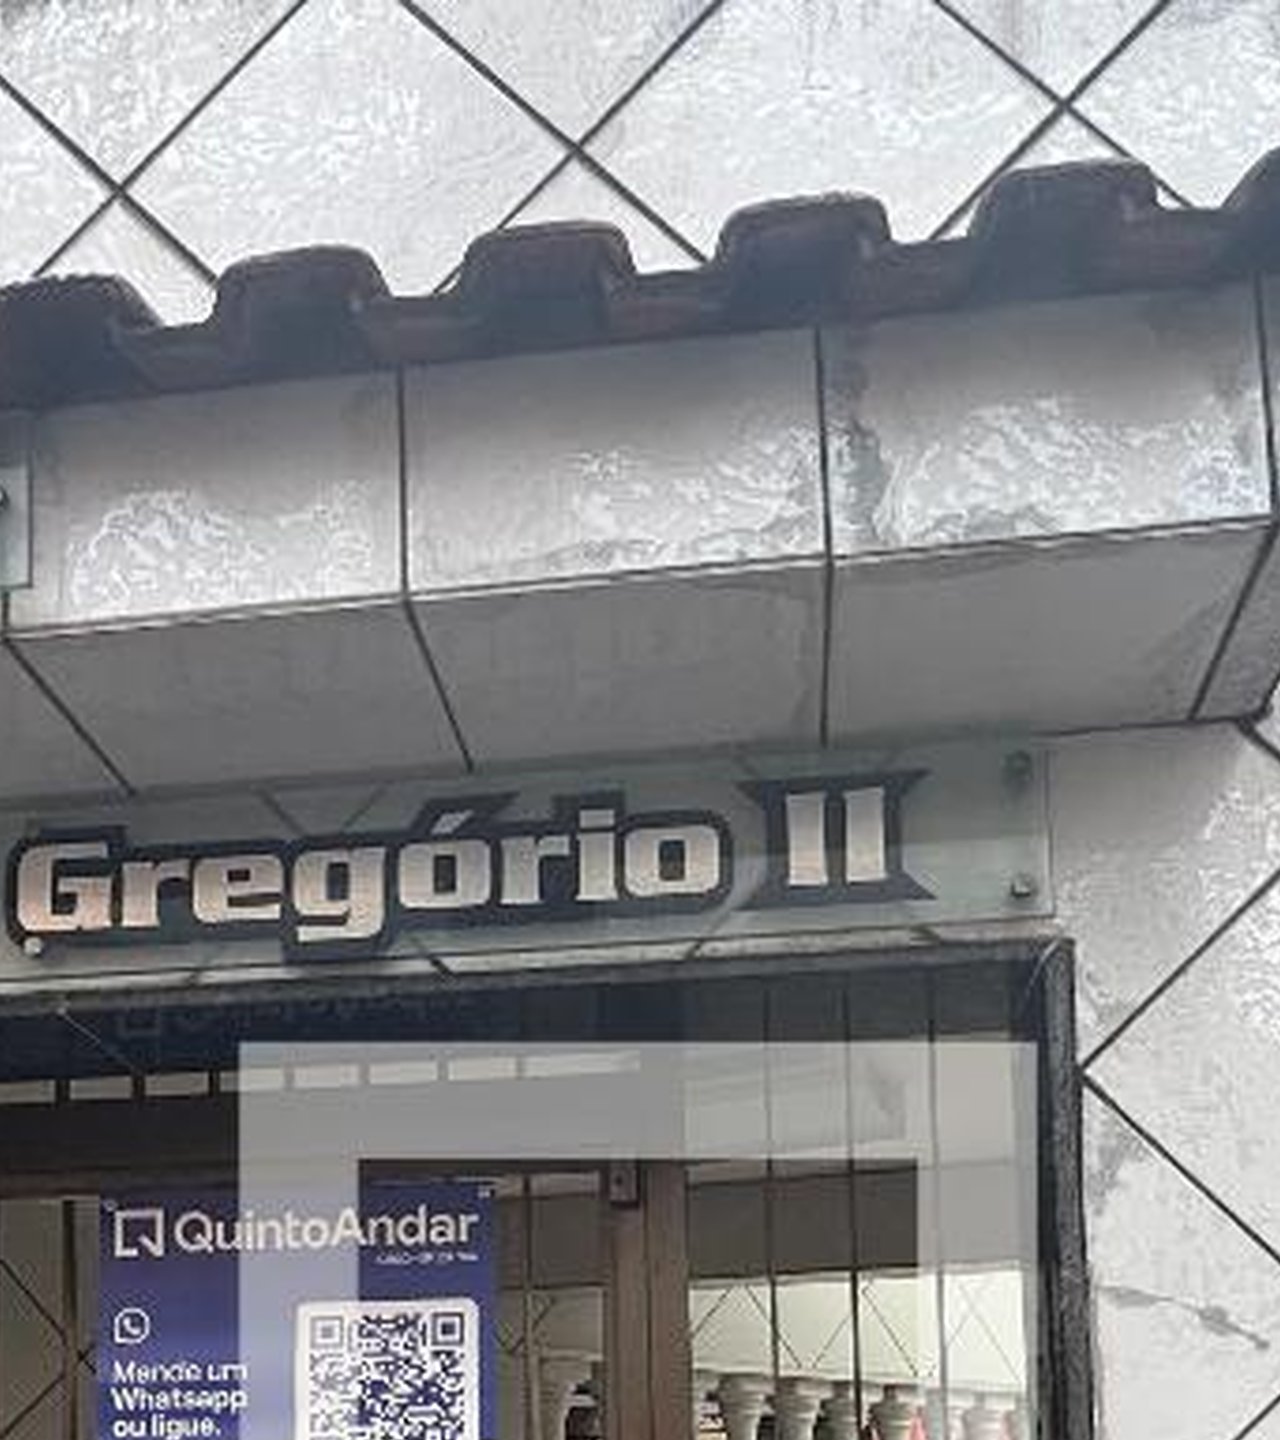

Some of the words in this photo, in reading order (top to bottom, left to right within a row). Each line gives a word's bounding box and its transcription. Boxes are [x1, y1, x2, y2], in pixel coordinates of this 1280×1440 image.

[10, 800, 726, 951] Gregório
[760, 777, 913, 898] II
[174, 1204, 480, 1254] QuintoAndar
[111, 1387, 249, 1416] Whatsapp
[113, 1419, 147, 1438] ou
